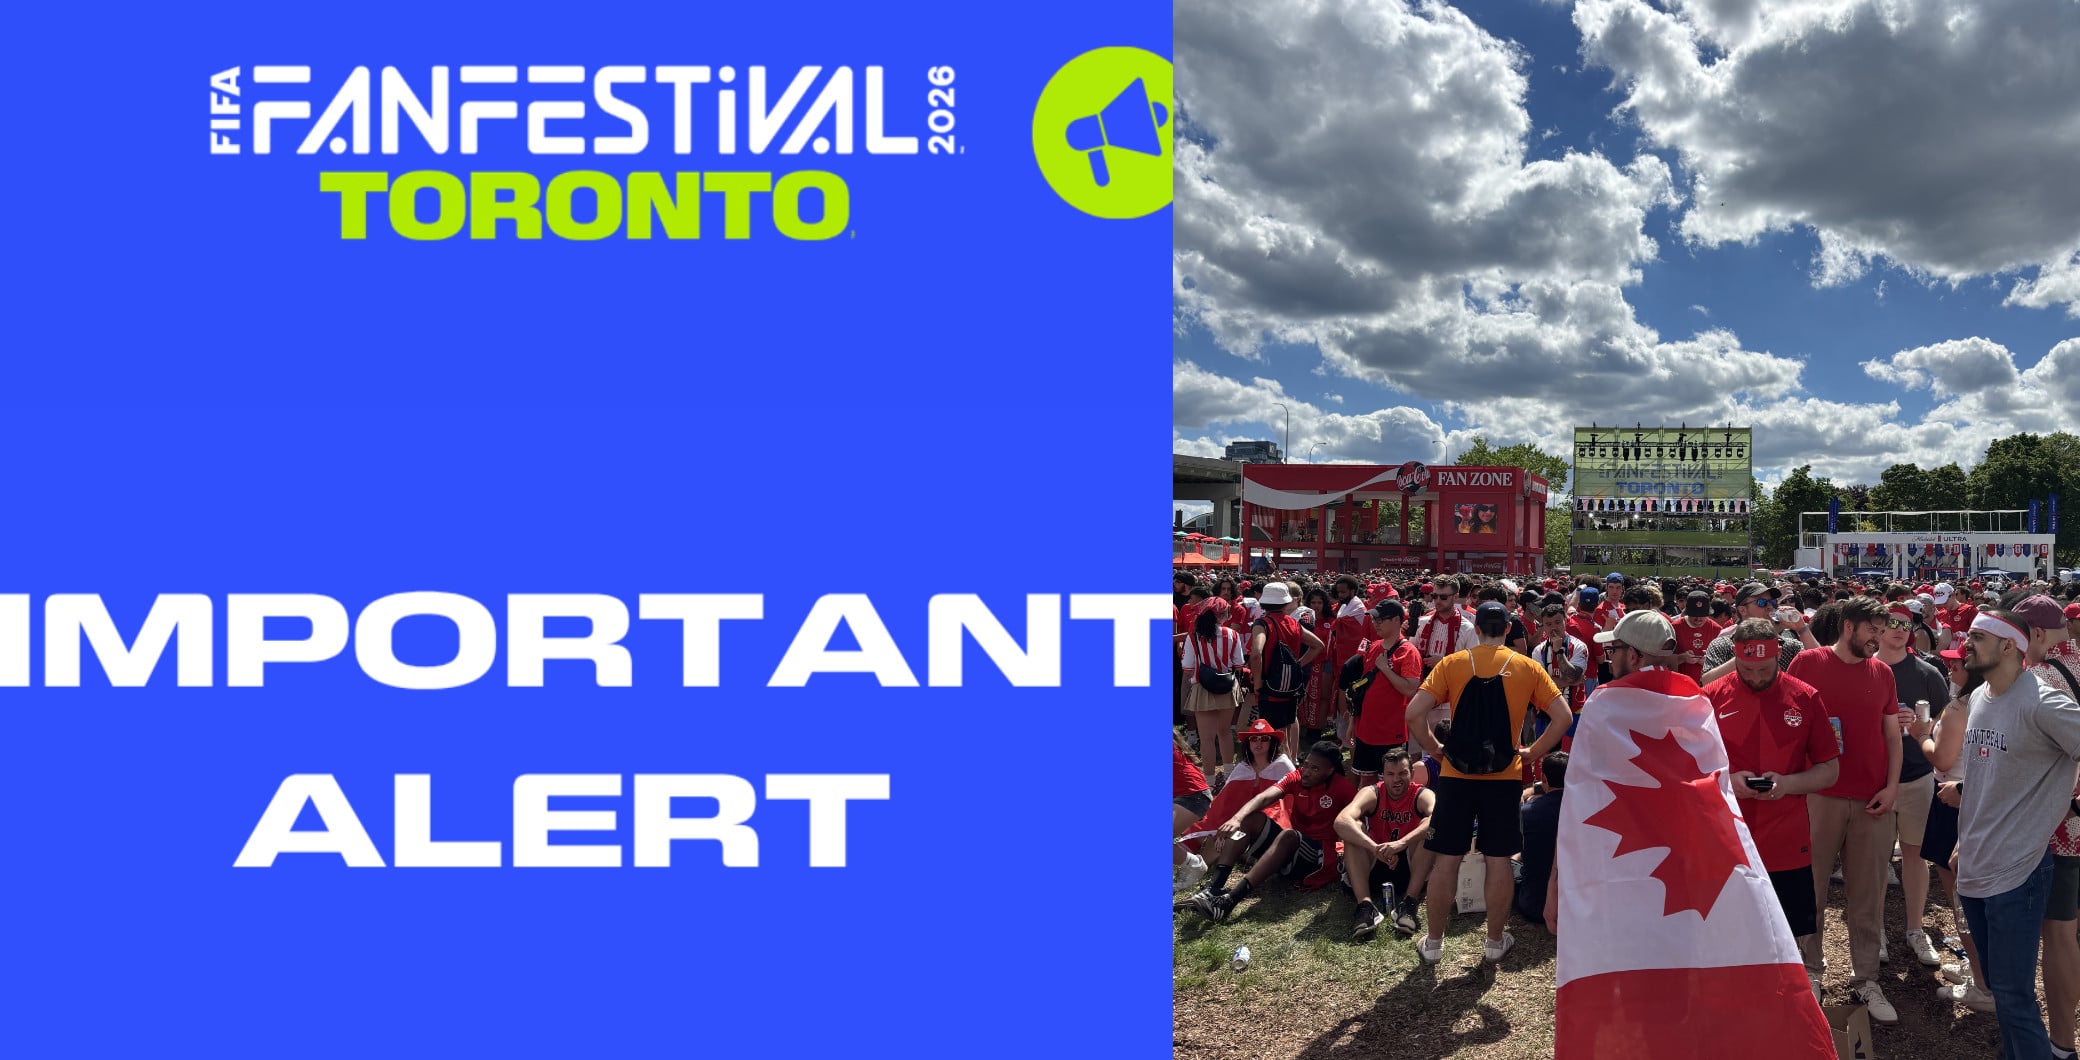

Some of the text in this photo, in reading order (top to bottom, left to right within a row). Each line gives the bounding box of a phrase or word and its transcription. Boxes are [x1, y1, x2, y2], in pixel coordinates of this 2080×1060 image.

[1437, 471, 1467, 486] FAN
[1470, 472, 1513, 487] ZONE
[1615, 481, 1705, 495] TORONTO
